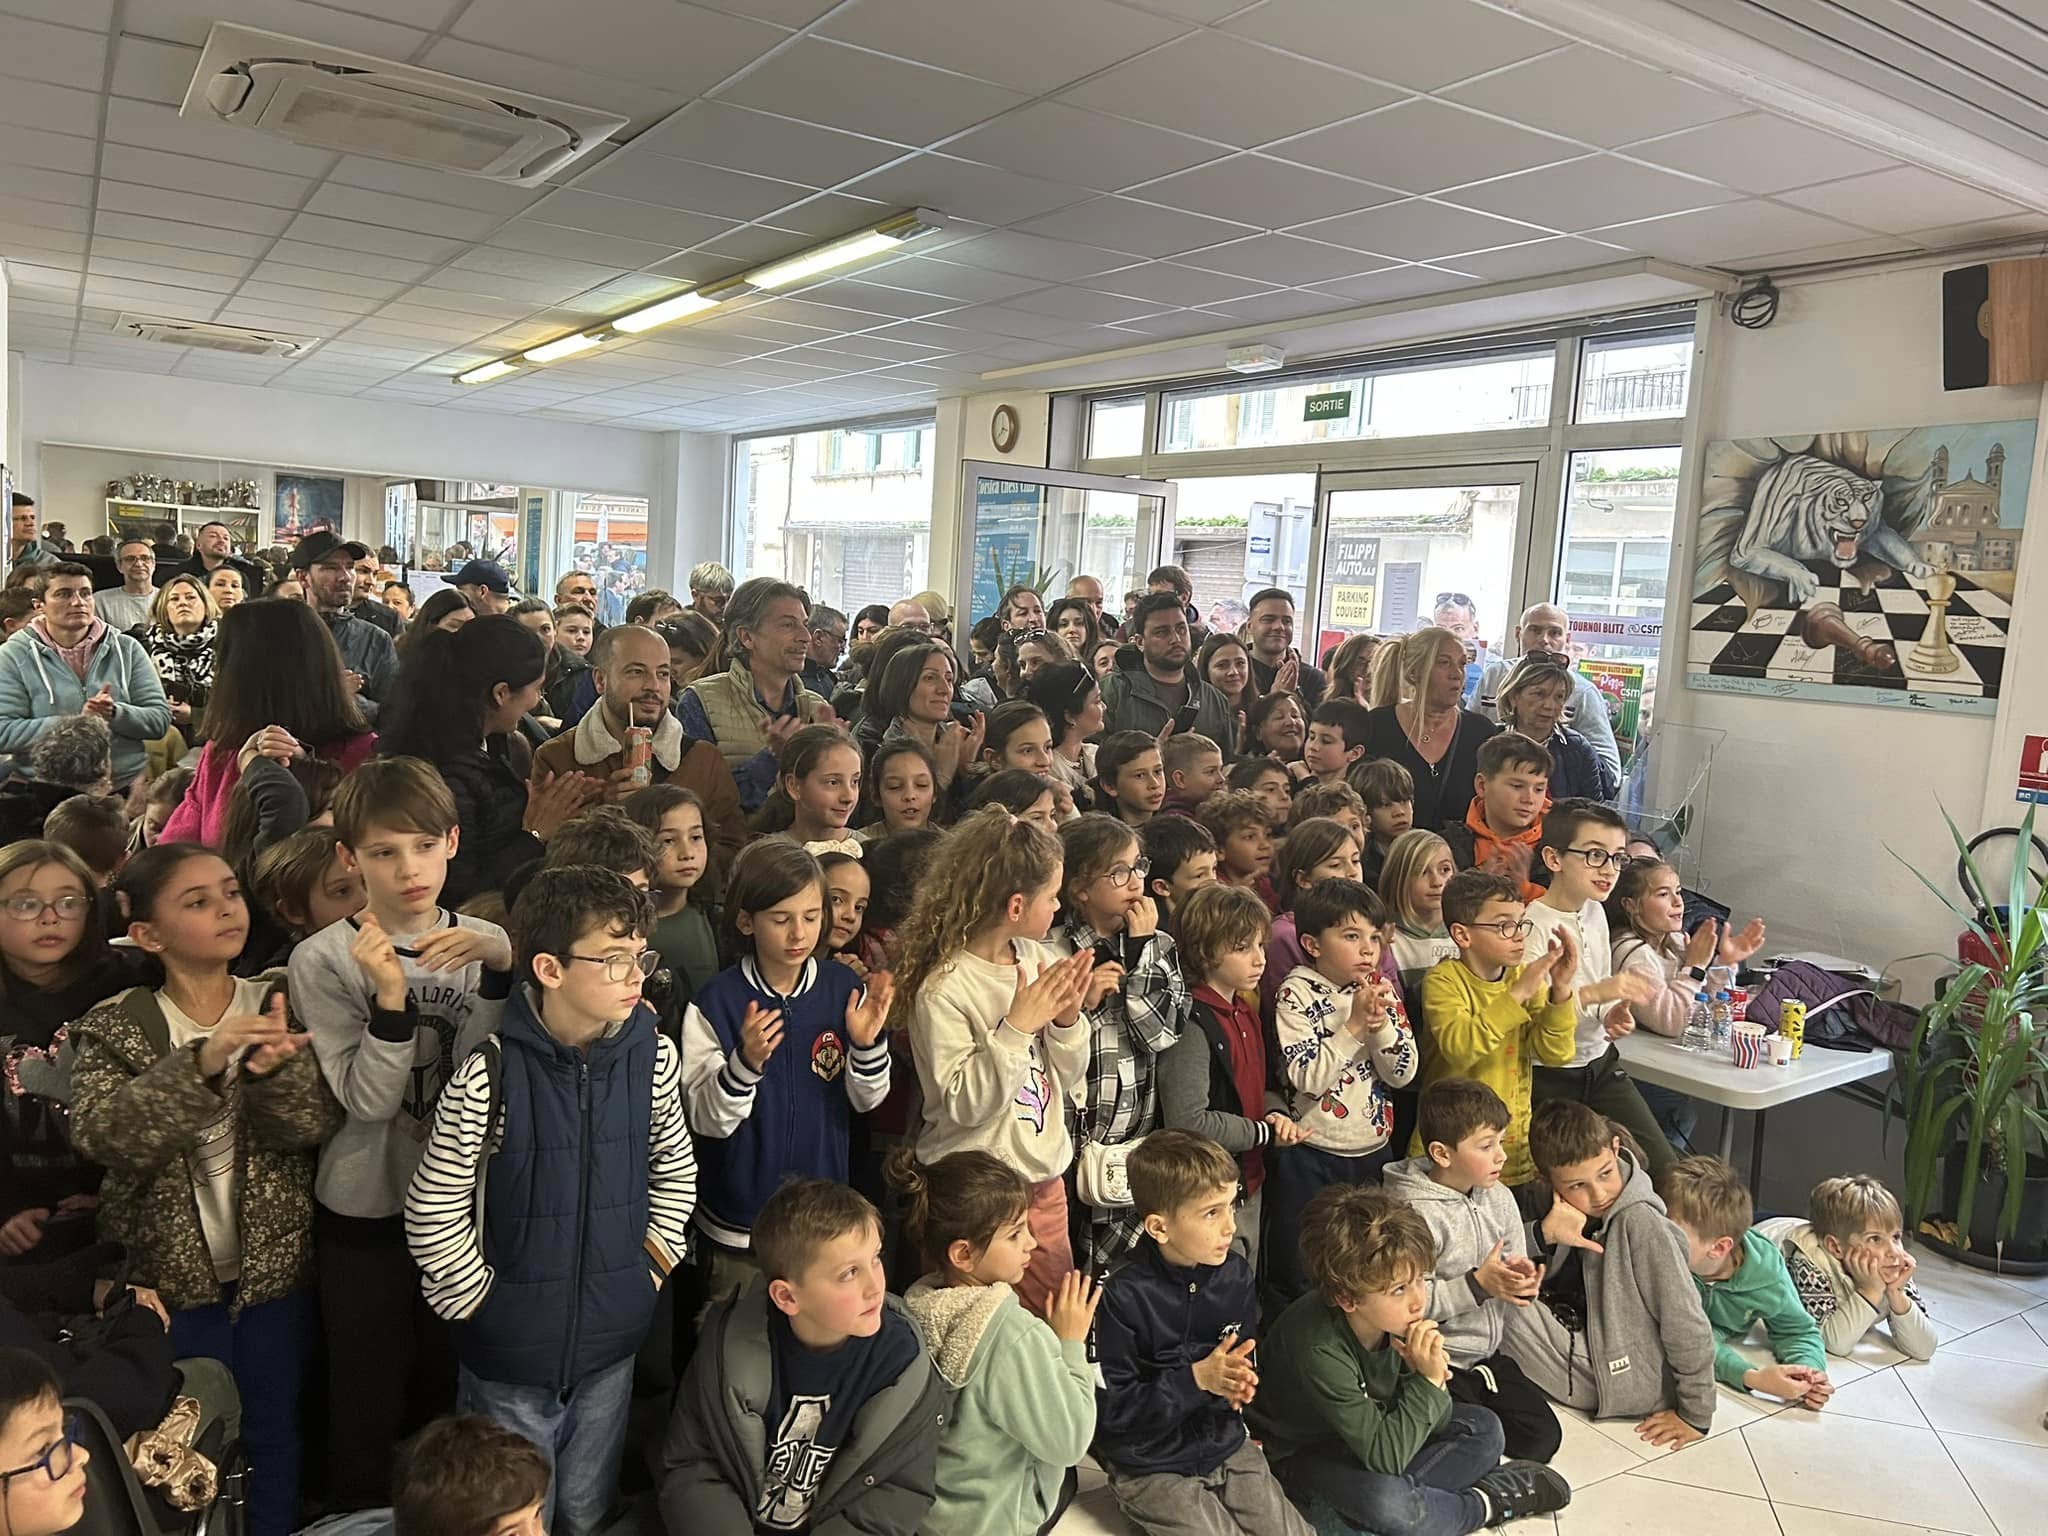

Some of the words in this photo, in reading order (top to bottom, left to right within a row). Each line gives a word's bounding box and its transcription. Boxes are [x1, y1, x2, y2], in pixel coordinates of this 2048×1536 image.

[1309, 398, 1345, 413] SORTIE
[1337, 543, 1377, 561] FILIPPI
[1335, 561, 1362, 576] AUTO
[1336, 592, 1369, 604] PARKING
[1335, 606, 1368, 619] COUVERT
[1569, 620, 1601, 632] TOURNOI
[1603, 623, 1624, 634] BLITZ
[1620, 688, 1640, 698] csm
